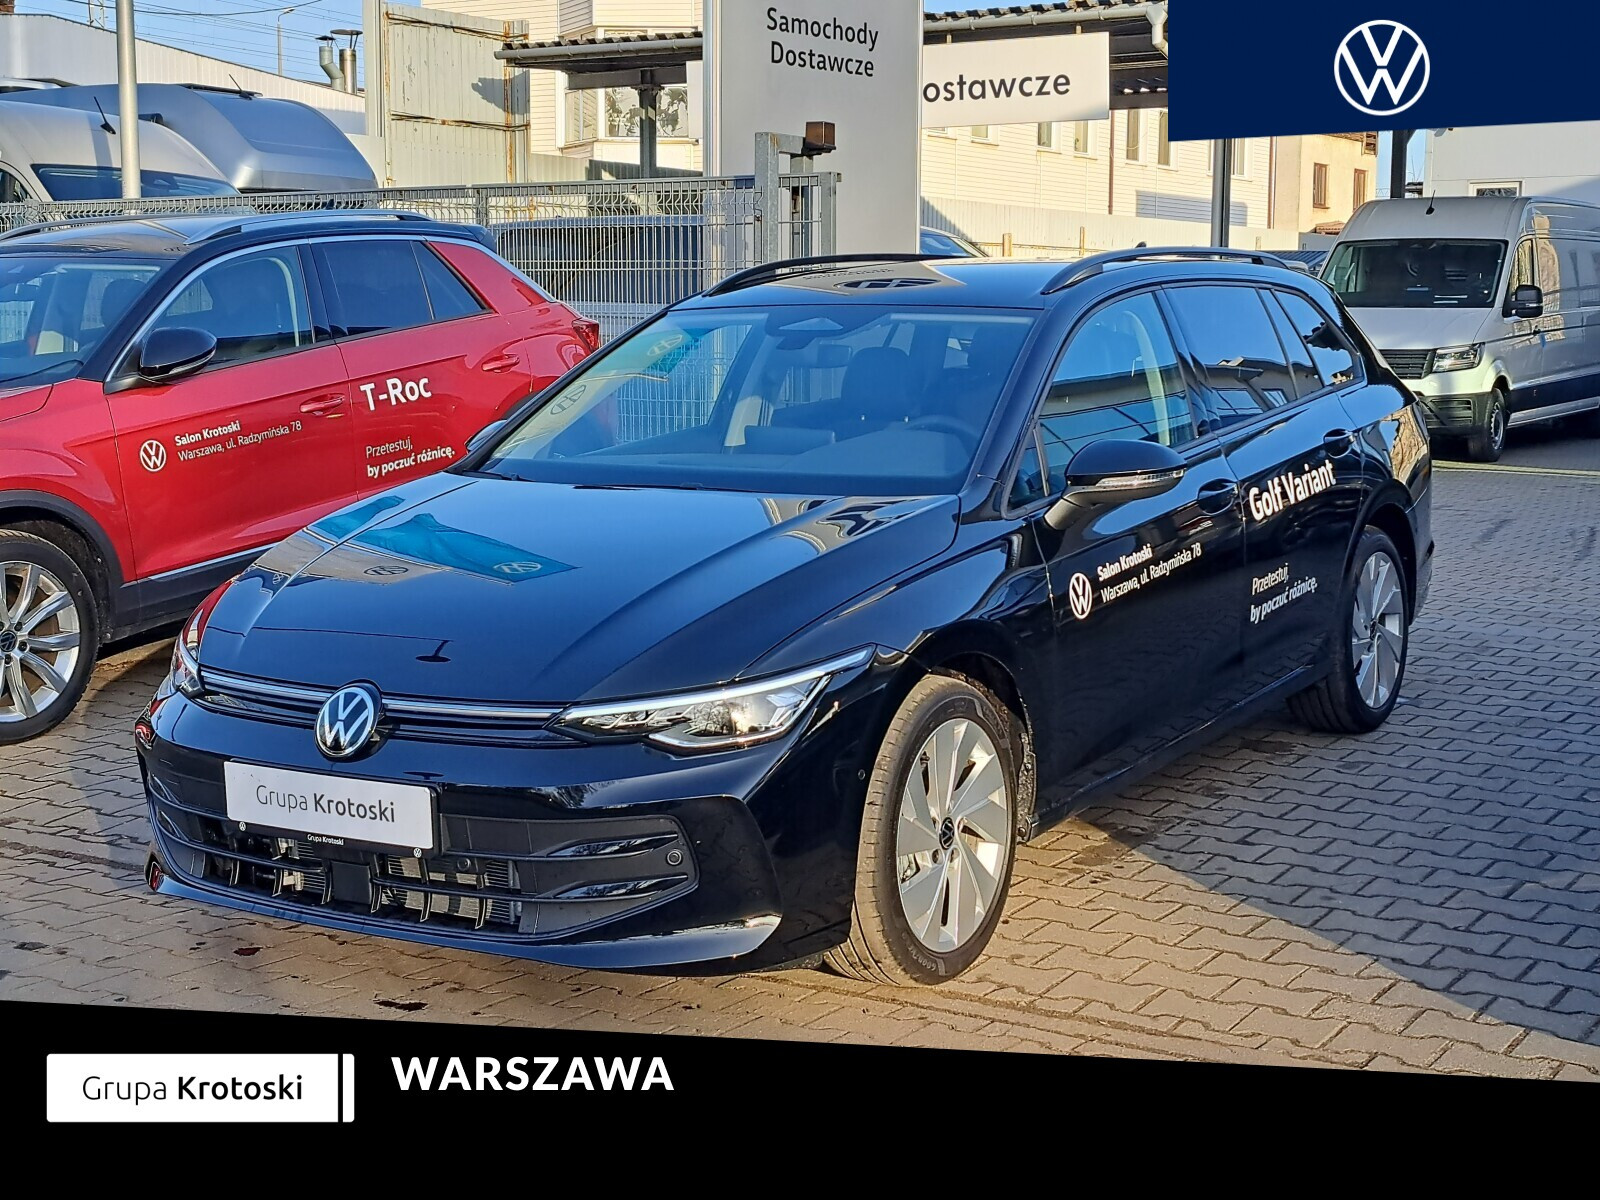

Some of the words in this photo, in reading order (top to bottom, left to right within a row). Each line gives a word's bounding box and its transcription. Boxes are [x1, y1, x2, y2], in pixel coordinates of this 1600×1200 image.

[766, 7, 879, 51] Samochody
[770, 40, 875, 77] Dostawcze
[922, 73, 1071, 103] ostawcze
[359, 377, 433, 411] T-Roc
[174, 432, 202, 446] Salon
[202, 420, 241, 439] Krotoski
[177, 442, 225, 461] Warszawa,
[225, 438, 236, 450] ul.
[238, 424, 290, 446] Radzymińska
[290, 420, 302, 432] 78
[365, 436, 413, 459] Przetestuj,
[366, 464, 380, 478] by
[381, 452, 416, 476] poczuć
[417, 446, 456, 464] różnicę.
[1248, 477, 1284, 521] Golf
[1280, 459, 1337, 505] Variant
[1097, 562, 1122, 581] Salon
[1120, 543, 1153, 571] Krotoski
[1100, 576, 1140, 604] Warszawa,
[1140, 568, 1150, 585] ul.
[1150, 549, 1192, 580] Radzymińska
[1191, 542, 1202, 560] 78
[1251, 562, 1290, 596] Przetestuj,
[1250, 604, 1262, 625] by
[1261, 586, 1290, 621] poczuć
[1289, 576, 1318, 601] różnicę.
[256, 785, 308, 813] Grupa
[313, 793, 396, 823] Krotoski
